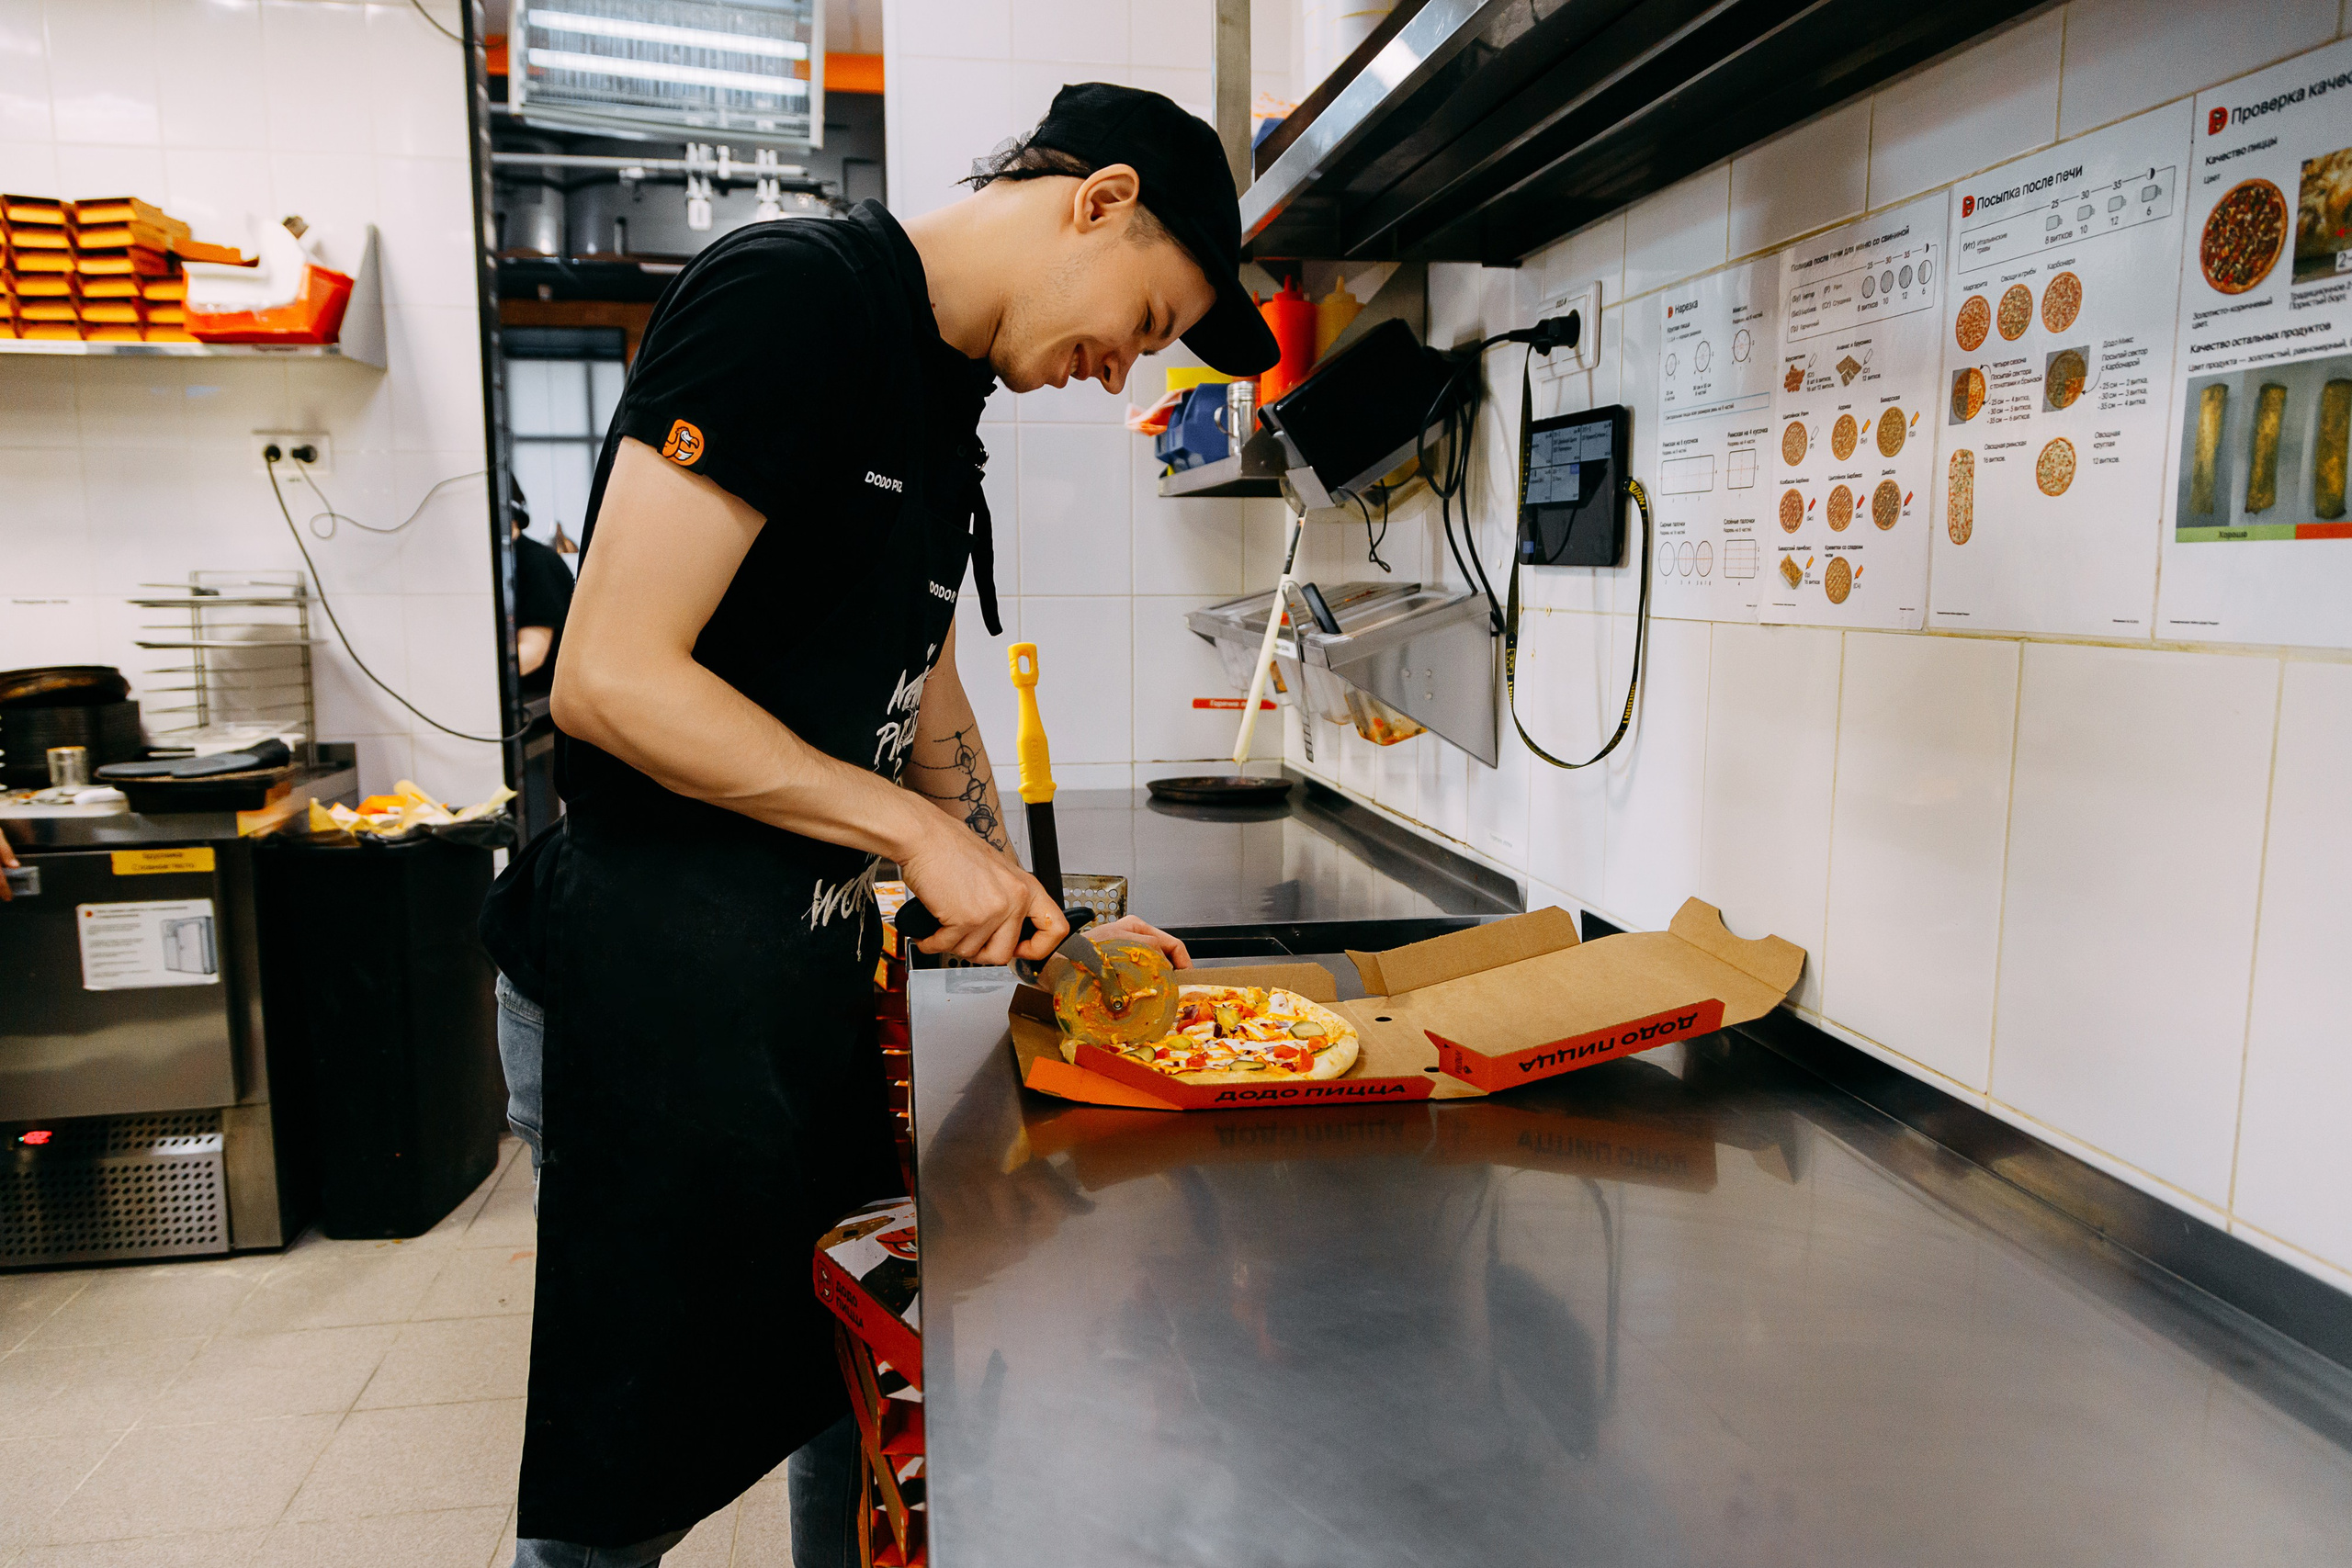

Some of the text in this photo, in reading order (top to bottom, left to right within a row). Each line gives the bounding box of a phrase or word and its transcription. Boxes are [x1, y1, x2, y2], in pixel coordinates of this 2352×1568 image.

[2232, 88, 2305, 124] Проверка
[2206, 147, 2246, 165] Качество
[1977, 165, 2083, 210] Посыпка после печи
[2113, 180, 2121, 189] 35
[2081, 190, 2089, 199] 30
[2051, 199, 2059, 209] 25
[2147, 206, 2151, 216] 6
[2080, 225, 2087, 234] 10
[2110, 217, 2119, 225] 12
[1882, 225, 1909, 243] свининой
[2045, 231, 2073, 244] 8 витков
[2047, 257, 2075, 270] Карбонара
[1963, 280, 1987, 292] Маргарита
[1675, 300, 1698, 314] Нарезка
[2190, 322, 2332, 354] Качество остальных продуктов
[865, 471, 891, 489] DODO
[930, 581, 951, 601] DODO
[1519, 1012, 1698, 1073] ДОДО ПИЦЦА
[1215, 1084, 1406, 1102] ДОДО ПИЦЦА
[836, 1280, 857, 1307] ДОДО
[836, 1296, 864, 1330] ПИЦЦА
